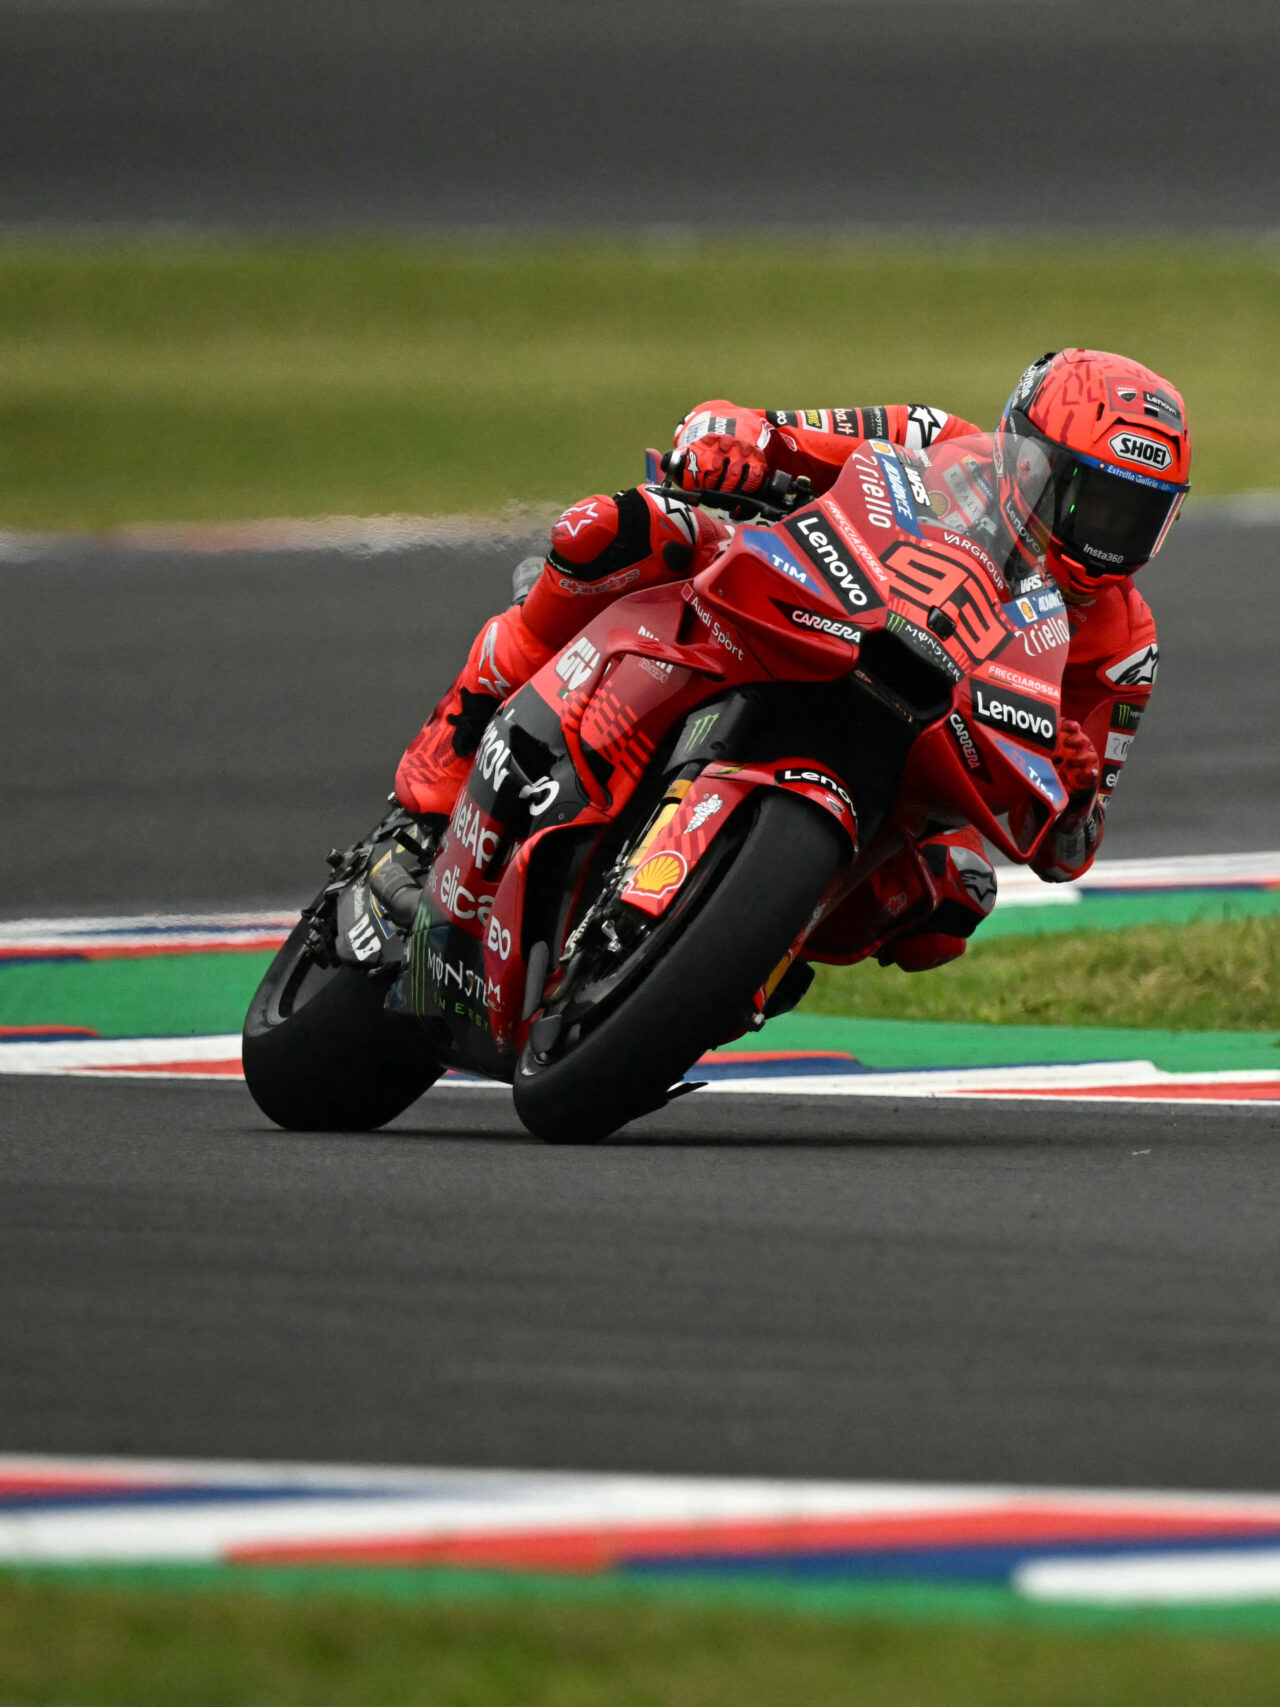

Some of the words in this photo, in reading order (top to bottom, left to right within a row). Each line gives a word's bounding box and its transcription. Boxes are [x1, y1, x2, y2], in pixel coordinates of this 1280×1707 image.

[1119, 438, 1167, 466] SHOEI
[857, 461, 891, 528] riello
[904, 466, 931, 506] WRS
[1107, 465, 1135, 482] Estrella
[1136, 474, 1159, 489] Galicia
[824, 500, 888, 582] FRECCIAROSSA
[1006, 501, 1041, 556] Lenovo
[771, 554, 807, 584] TIM
[796, 516, 868, 606] Lenovo
[943, 531, 1004, 590] VARGROUP
[1083, 543, 1124, 564] Insta360
[880, 542, 1012, 663] 93
[1020, 573, 1043, 594] WRS
[691, 596, 712, 627] Audi
[711, 622, 744, 661] Sport
[791, 610, 862, 643] CARRERA
[988, 665, 1060, 698] FRECCIAROSSA
[976, 690, 1054, 739] Lenovo
[949, 713, 981, 770] CARRERA
[784, 770, 857, 817] Leno
[452, 802, 506, 869] etAp
